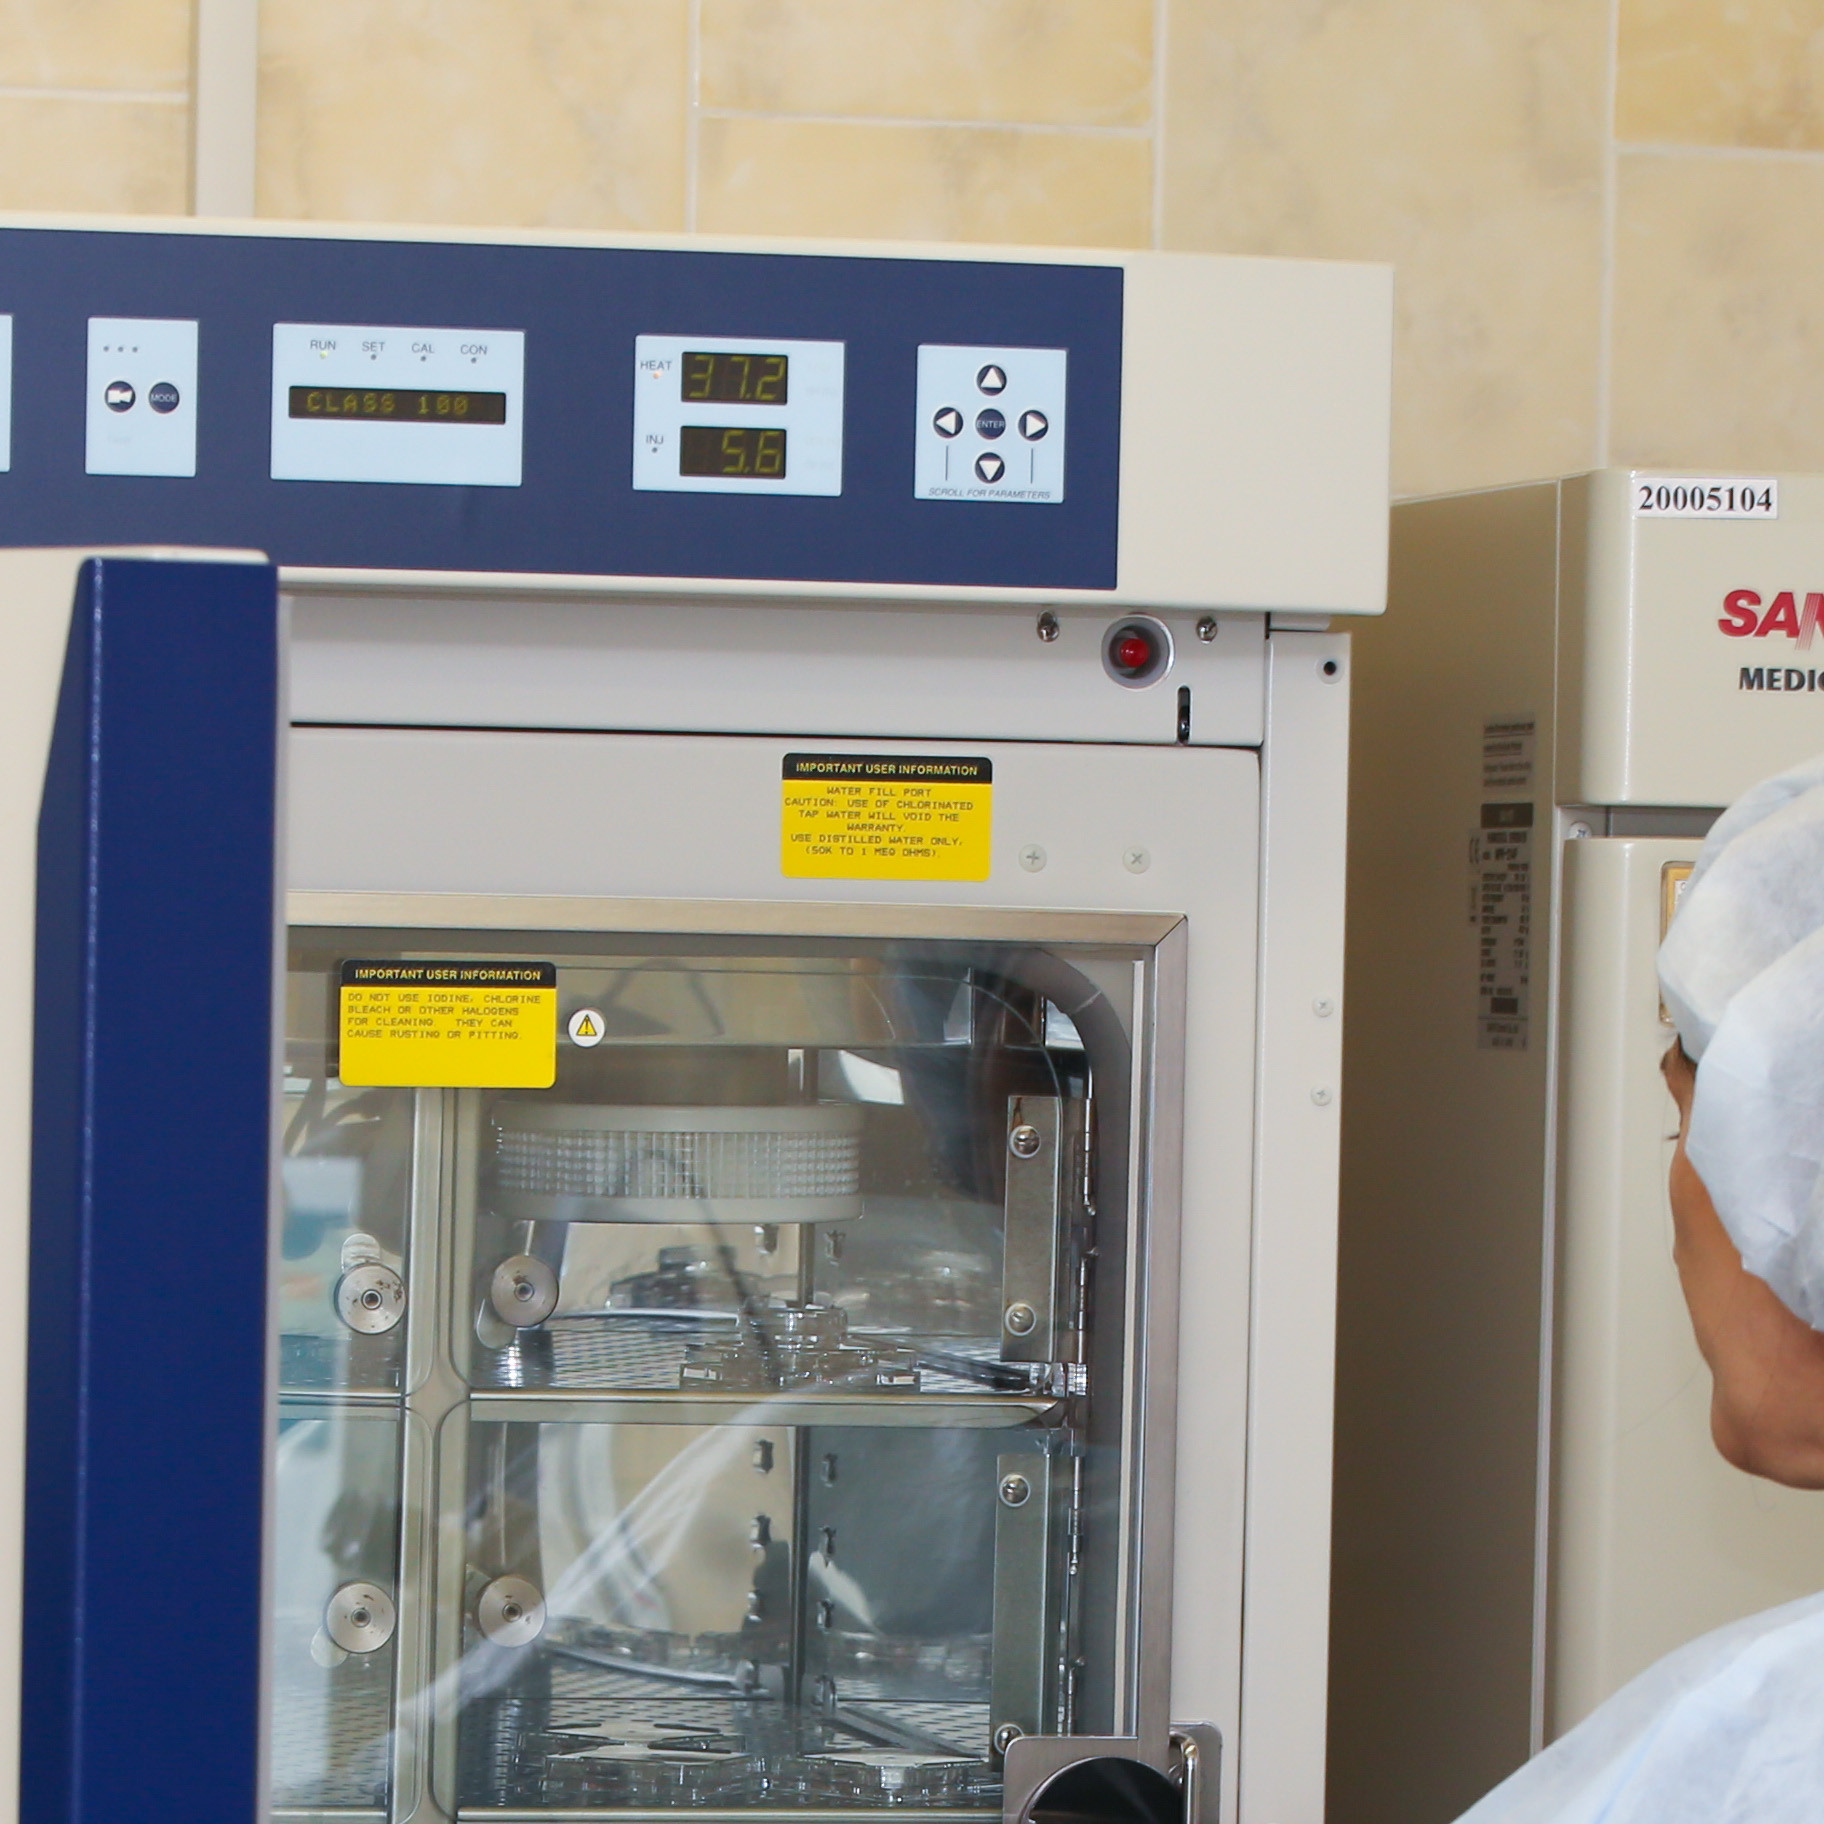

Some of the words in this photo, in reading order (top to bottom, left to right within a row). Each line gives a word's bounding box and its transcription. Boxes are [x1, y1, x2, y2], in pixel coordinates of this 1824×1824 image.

[310, 340, 336, 350] RUN
[362, 342, 385, 352] SET
[412, 343, 435, 354] CAL
[460, 345, 488, 355] CON
[640, 361, 672, 370] HEAT
[689, 355, 786, 400] 37.2
[306, 392, 395, 414] CLASS
[419, 395, 469, 415] 100
[646, 435, 664, 444] INJ
[723, 430, 781, 473] 5.6
[929, 487, 964, 497] SCROLL
[967, 489, 988, 497] FOR
[988, 489, 1050, 499] PARAMETERS
[1638, 486, 1772, 512] 20005104
[796, 764, 863, 773] IMPORTANT
[866, 764, 896, 774] USER
[899, 764, 978, 775] INFORMATION
[869, 788, 896, 796] FILL
[847, 800, 868, 808] USE
[876, 800, 889, 808] OF
[896, 801, 974, 810] CHLORINATED
[799, 810, 819, 818] TAP
[827, 811, 861, 819] WATER
[869, 812, 896, 820] WILL
[904, 813, 931, 821] VOID
[940, 814, 959, 822] THE
[791, 834, 811, 842] USE
[820, 835, 882, 843] DISTILLED
[889, 837, 923, 845] WATER
[840, 847, 854, 855] TO
[355, 969, 424, 979] IMPORTANT
[426, 970, 457, 979] USER
[460, 970, 541, 981] INFORMATION
[348, 993, 362, 1001] DO
[398, 994, 419, 1002] USE
[484, 995, 541, 1004] CHLORINE
[348, 1006, 390, 1014] BLEACH
[419, 1007, 454, 1015] OTHER
[462, 1007, 519, 1015] HALOGENS
[456, 1019, 483, 1027] THEY
[347, 1030, 383, 1038] CAUSE
[447, 1031, 461, 1039] OR
